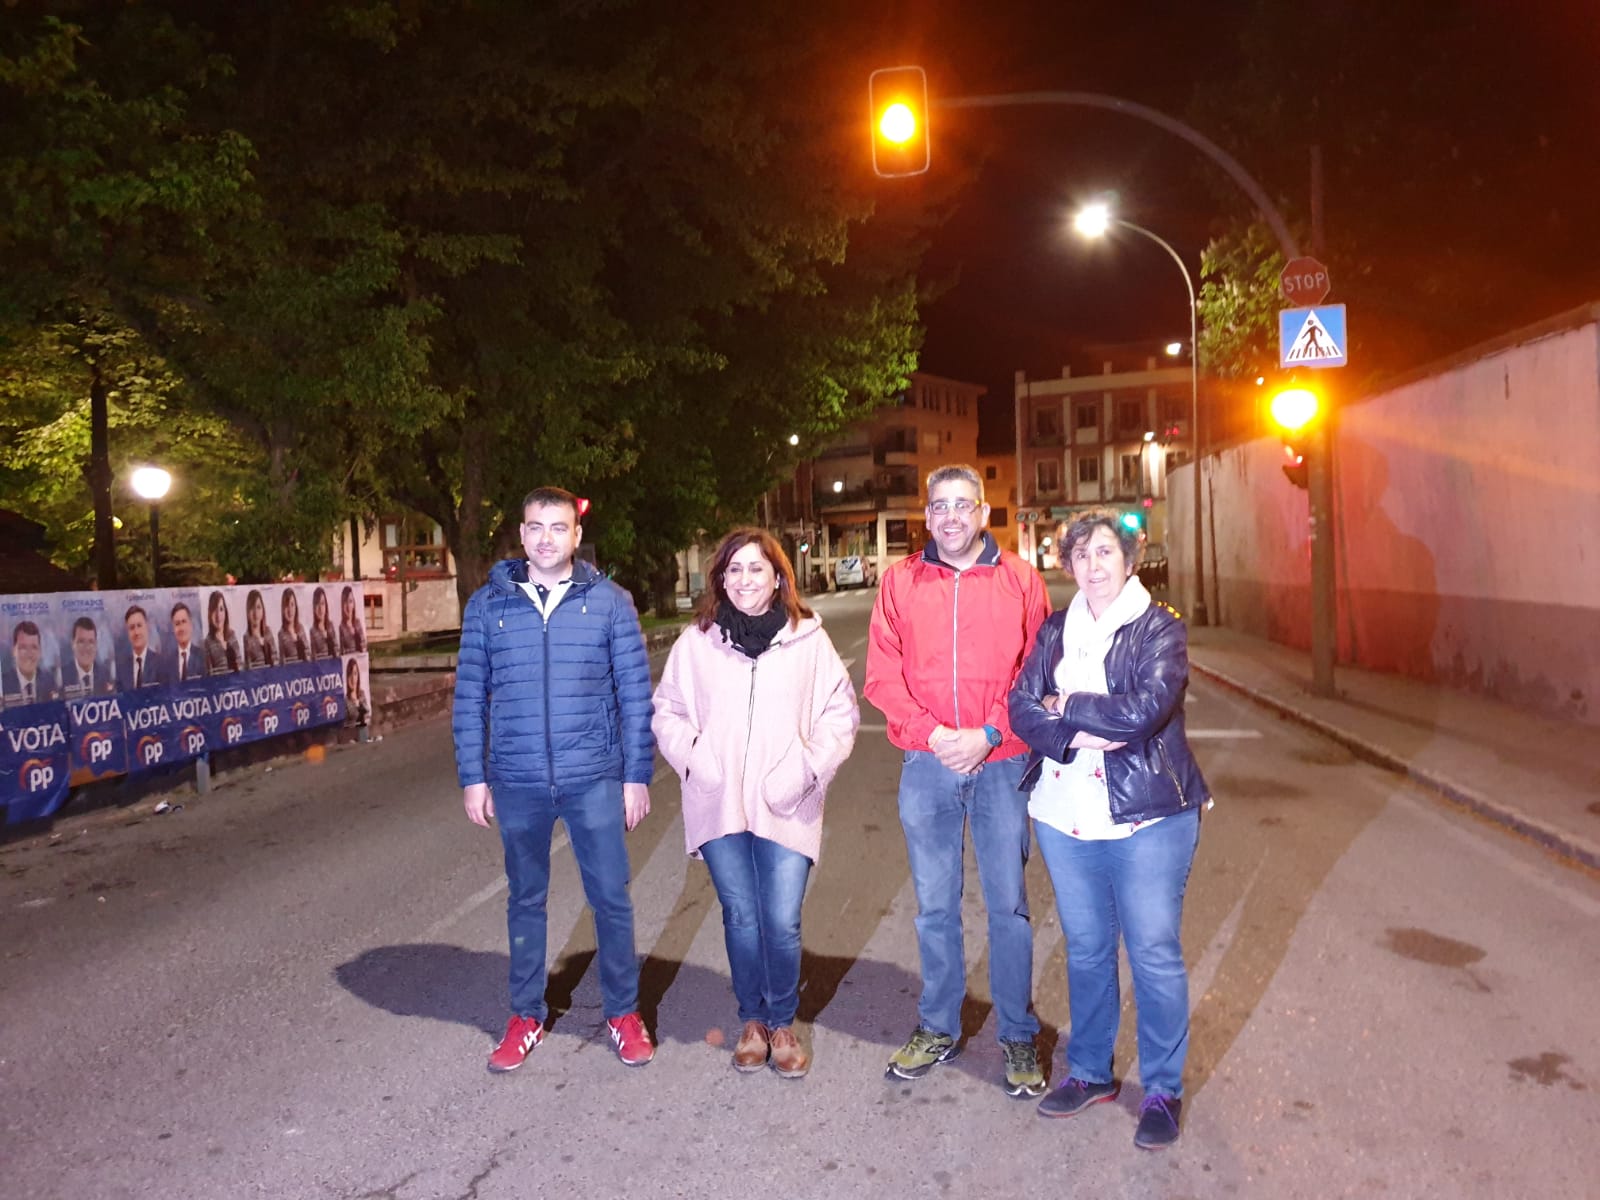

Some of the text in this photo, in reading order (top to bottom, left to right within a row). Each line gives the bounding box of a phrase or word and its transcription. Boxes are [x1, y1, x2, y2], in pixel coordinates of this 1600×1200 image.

[1284, 271, 1325, 292] STOP
[285, 678, 315, 697] VOTA
[316, 672, 343, 692] VOTA
[213, 690, 249, 713] VOTA
[251, 683, 284, 705] VOTA
[72, 699, 122, 726] VOTA
[127, 704, 172, 730] VOTA
[173, 697, 211, 720] VOTA
[8, 724, 66, 753] VOTA
